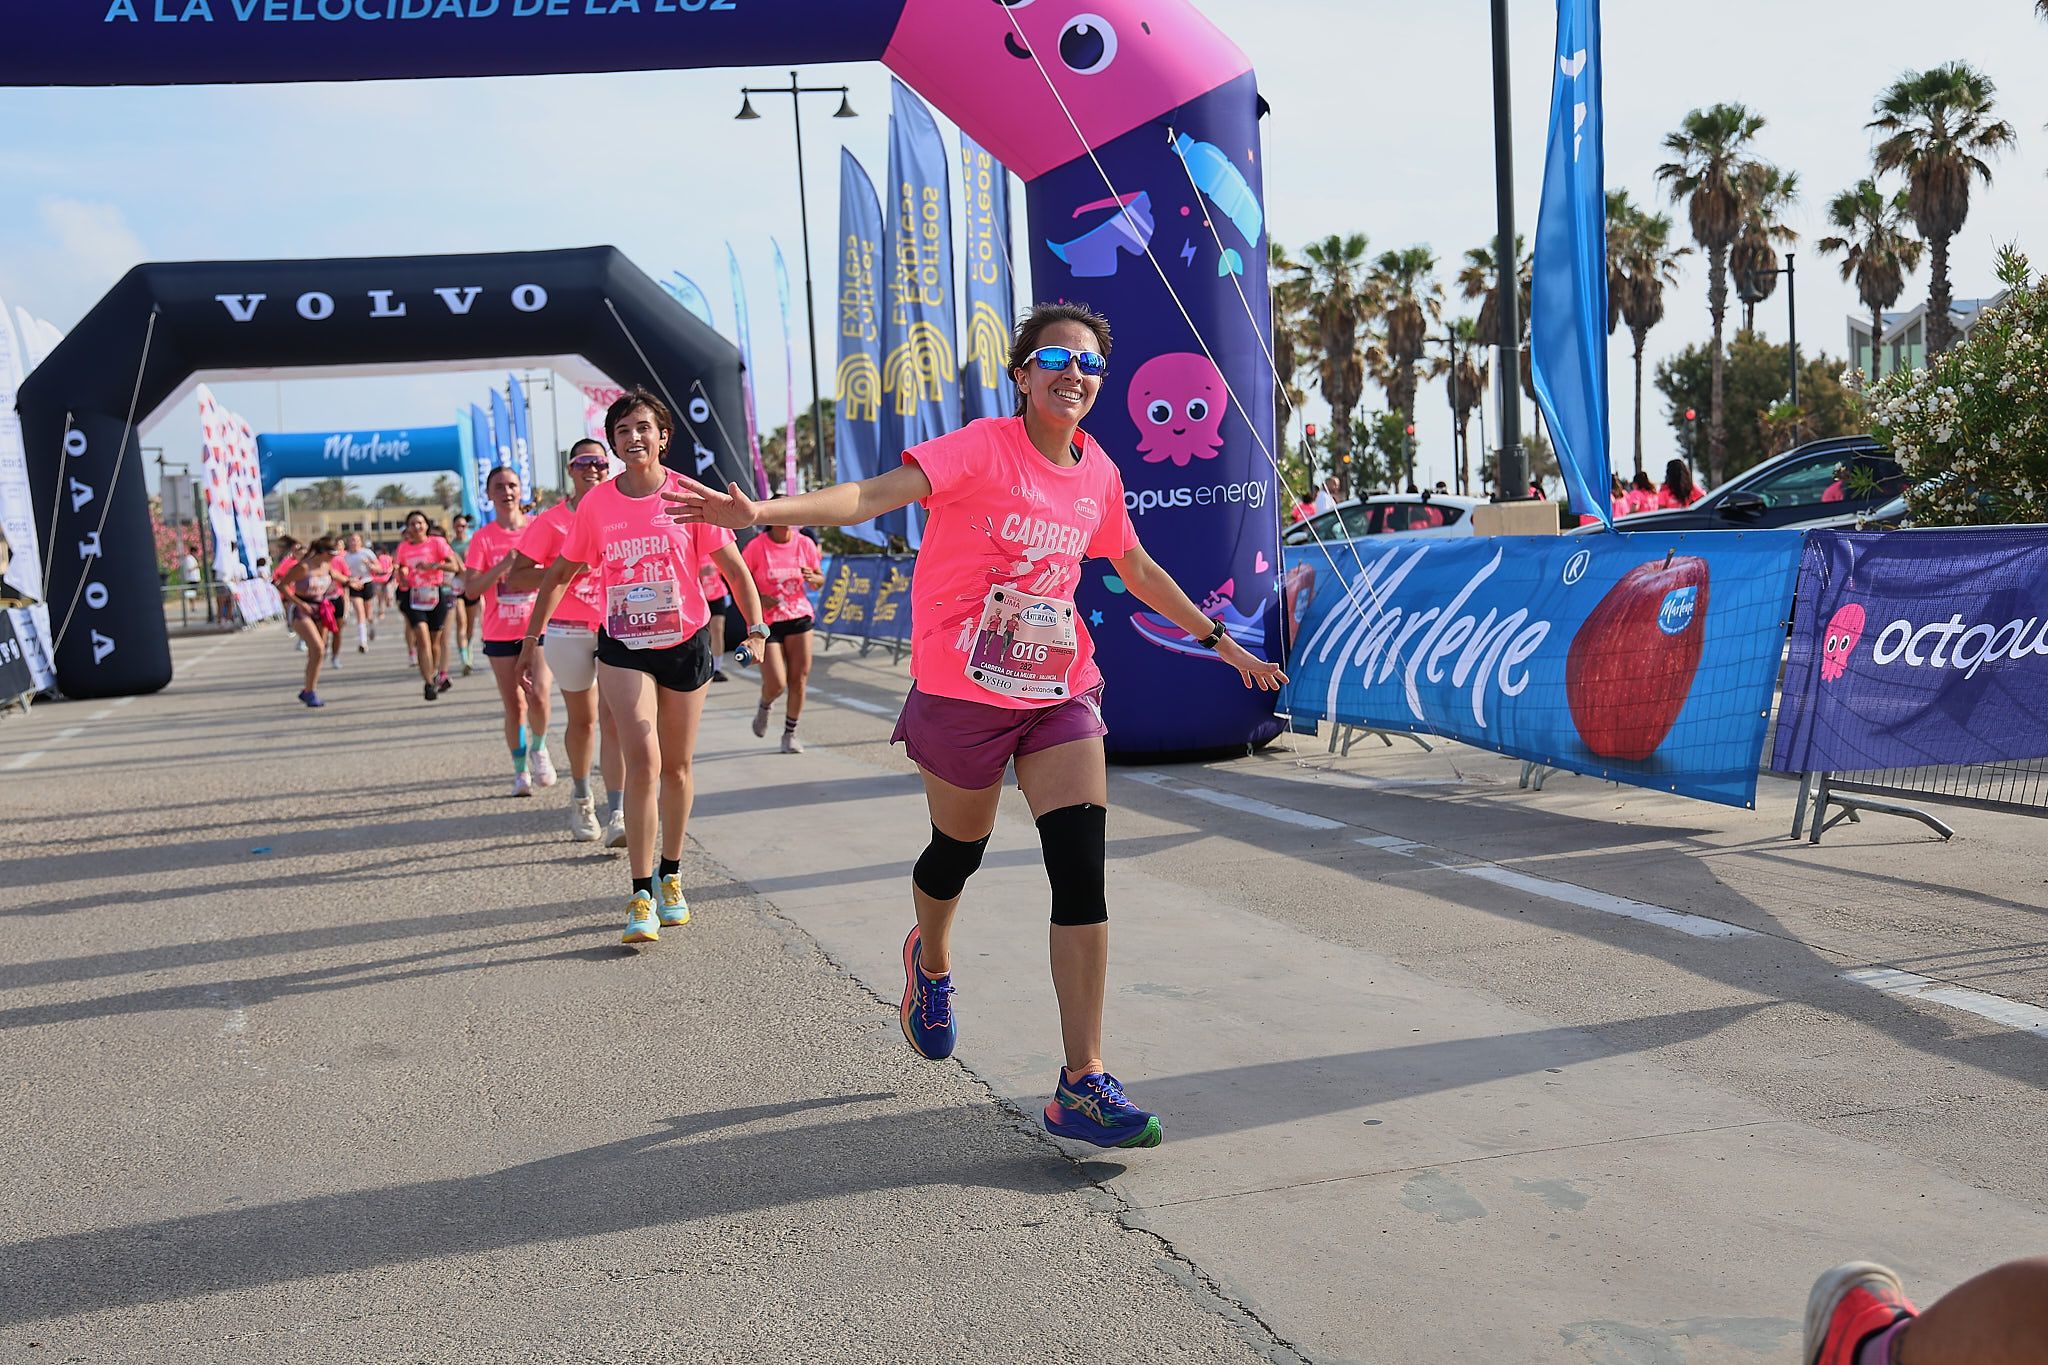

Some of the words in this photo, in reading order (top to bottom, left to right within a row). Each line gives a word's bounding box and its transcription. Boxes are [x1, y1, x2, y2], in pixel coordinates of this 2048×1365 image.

[104, 0, 139, 22] A
[154, 0, 214, 22] LA
[230, 0, 500, 21] VELOCIDAD
[512, 0, 570, 16] DE
[584, 0, 641, 14] LA
[215, 283, 549, 323] VOLVO
[323, 432, 411, 471] Marlene
[1195, 480, 1268, 509] energy
[64, 428, 117, 666] VOLVO
[605, 535, 671, 562] CARRERA
[1000, 513, 1088, 560] CARRERA
[629, 612, 657, 625] 016
[1300, 545, 1551, 729] Marlene
[1012, 641, 1048, 662] 016
[981, 661, 1005, 675] CARRERA
[1006, 669, 1013, 677] DE
[1027, 684, 1055, 694] Santande
